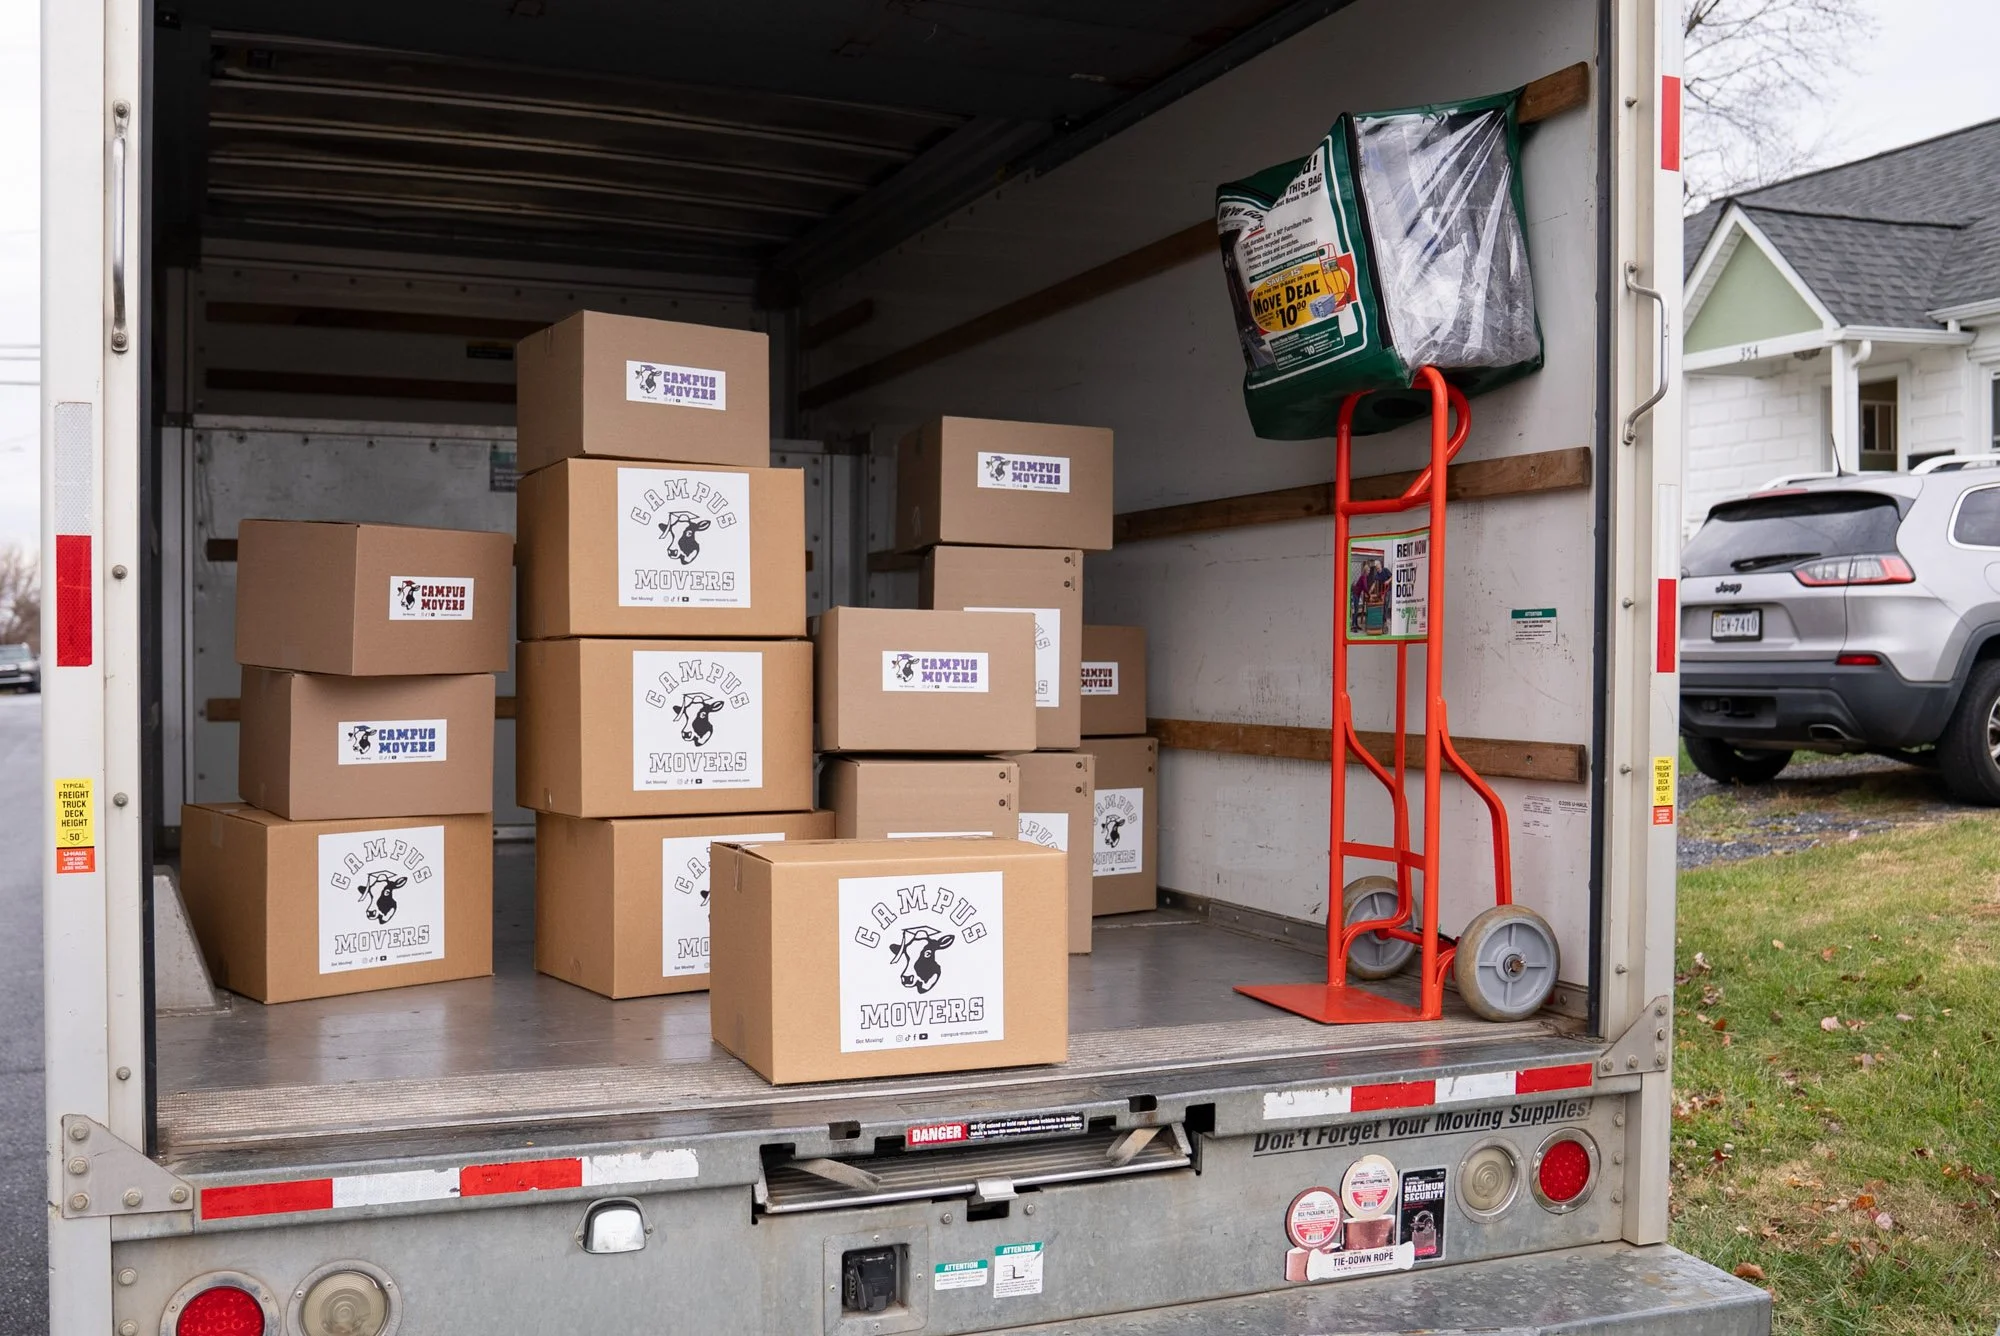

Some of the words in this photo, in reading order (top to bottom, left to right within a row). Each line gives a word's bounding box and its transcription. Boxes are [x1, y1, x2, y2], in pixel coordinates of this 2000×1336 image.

[1289, 180, 1305, 194] THIS
[1308, 173, 1322, 187] BAG
[1286, 195, 1300, 204] Break
[1301, 190, 1309, 198] The
[1284, 222, 1302, 234] Furniture
[1285, 280, 1320, 303] DEAL
[663, 371, 716, 388] CAMPUS
[663, 384, 716, 400] MOVERS
[1012, 460, 1061, 473] CAMPUS
[1012, 472, 1061, 485] MOVERS
[630, 478, 737, 529] CAMPUS
[1396, 542, 1413, 558] RENT
[1414, 540, 1427, 555] NOW
[635, 569, 735, 591] MOVERS
[1396, 566, 1417, 583] UTILITY
[421, 585, 466, 598] CAMPUS
[1396, 583, 1414, 598] DOLLY
[1715, 581, 1742, 595] Jeep
[421, 599, 465, 611] MOVERS
[921, 658, 978, 670] CAMPUS
[645, 659, 750, 710] CAMPUS
[921, 672, 978, 683] MOVERS
[378, 728, 436, 741] CAMPUS
[378, 741, 436, 754] MOVERS
[649, 752, 747, 773] MOVERS
[59, 791, 89, 799] FREIGHT
[62, 800, 86, 808] TRUCK
[65, 810, 84, 818] DECK
[61, 819, 88, 827] HEIGHT
[330, 838, 433, 890] CAMPUS
[854, 884, 988, 949] CAMPUS
[335, 925, 430, 955] MOVERS
[860, 997, 984, 1030] MOVERS
[1254, 1131, 1309, 1152] Don't
[1316, 1119, 1384, 1146] Forget
[1388, 1115, 1431, 1137] Your
[1435, 1109, 1503, 1130] Moving
[1509, 1096, 1594, 1126] Supplies!
[912, 1125, 962, 1143] DANGER
[1405, 1181, 1444, 1193] MAXIMUM
[1404, 1190, 1444, 1201] SECURITY
[1003, 1244, 1036, 1254] ATTENTION
[1333, 1254, 1371, 1266] TIE-DOWN
[1373, 1251, 1394, 1262] ROPE
[944, 1261, 979, 1271] ATTENTION
